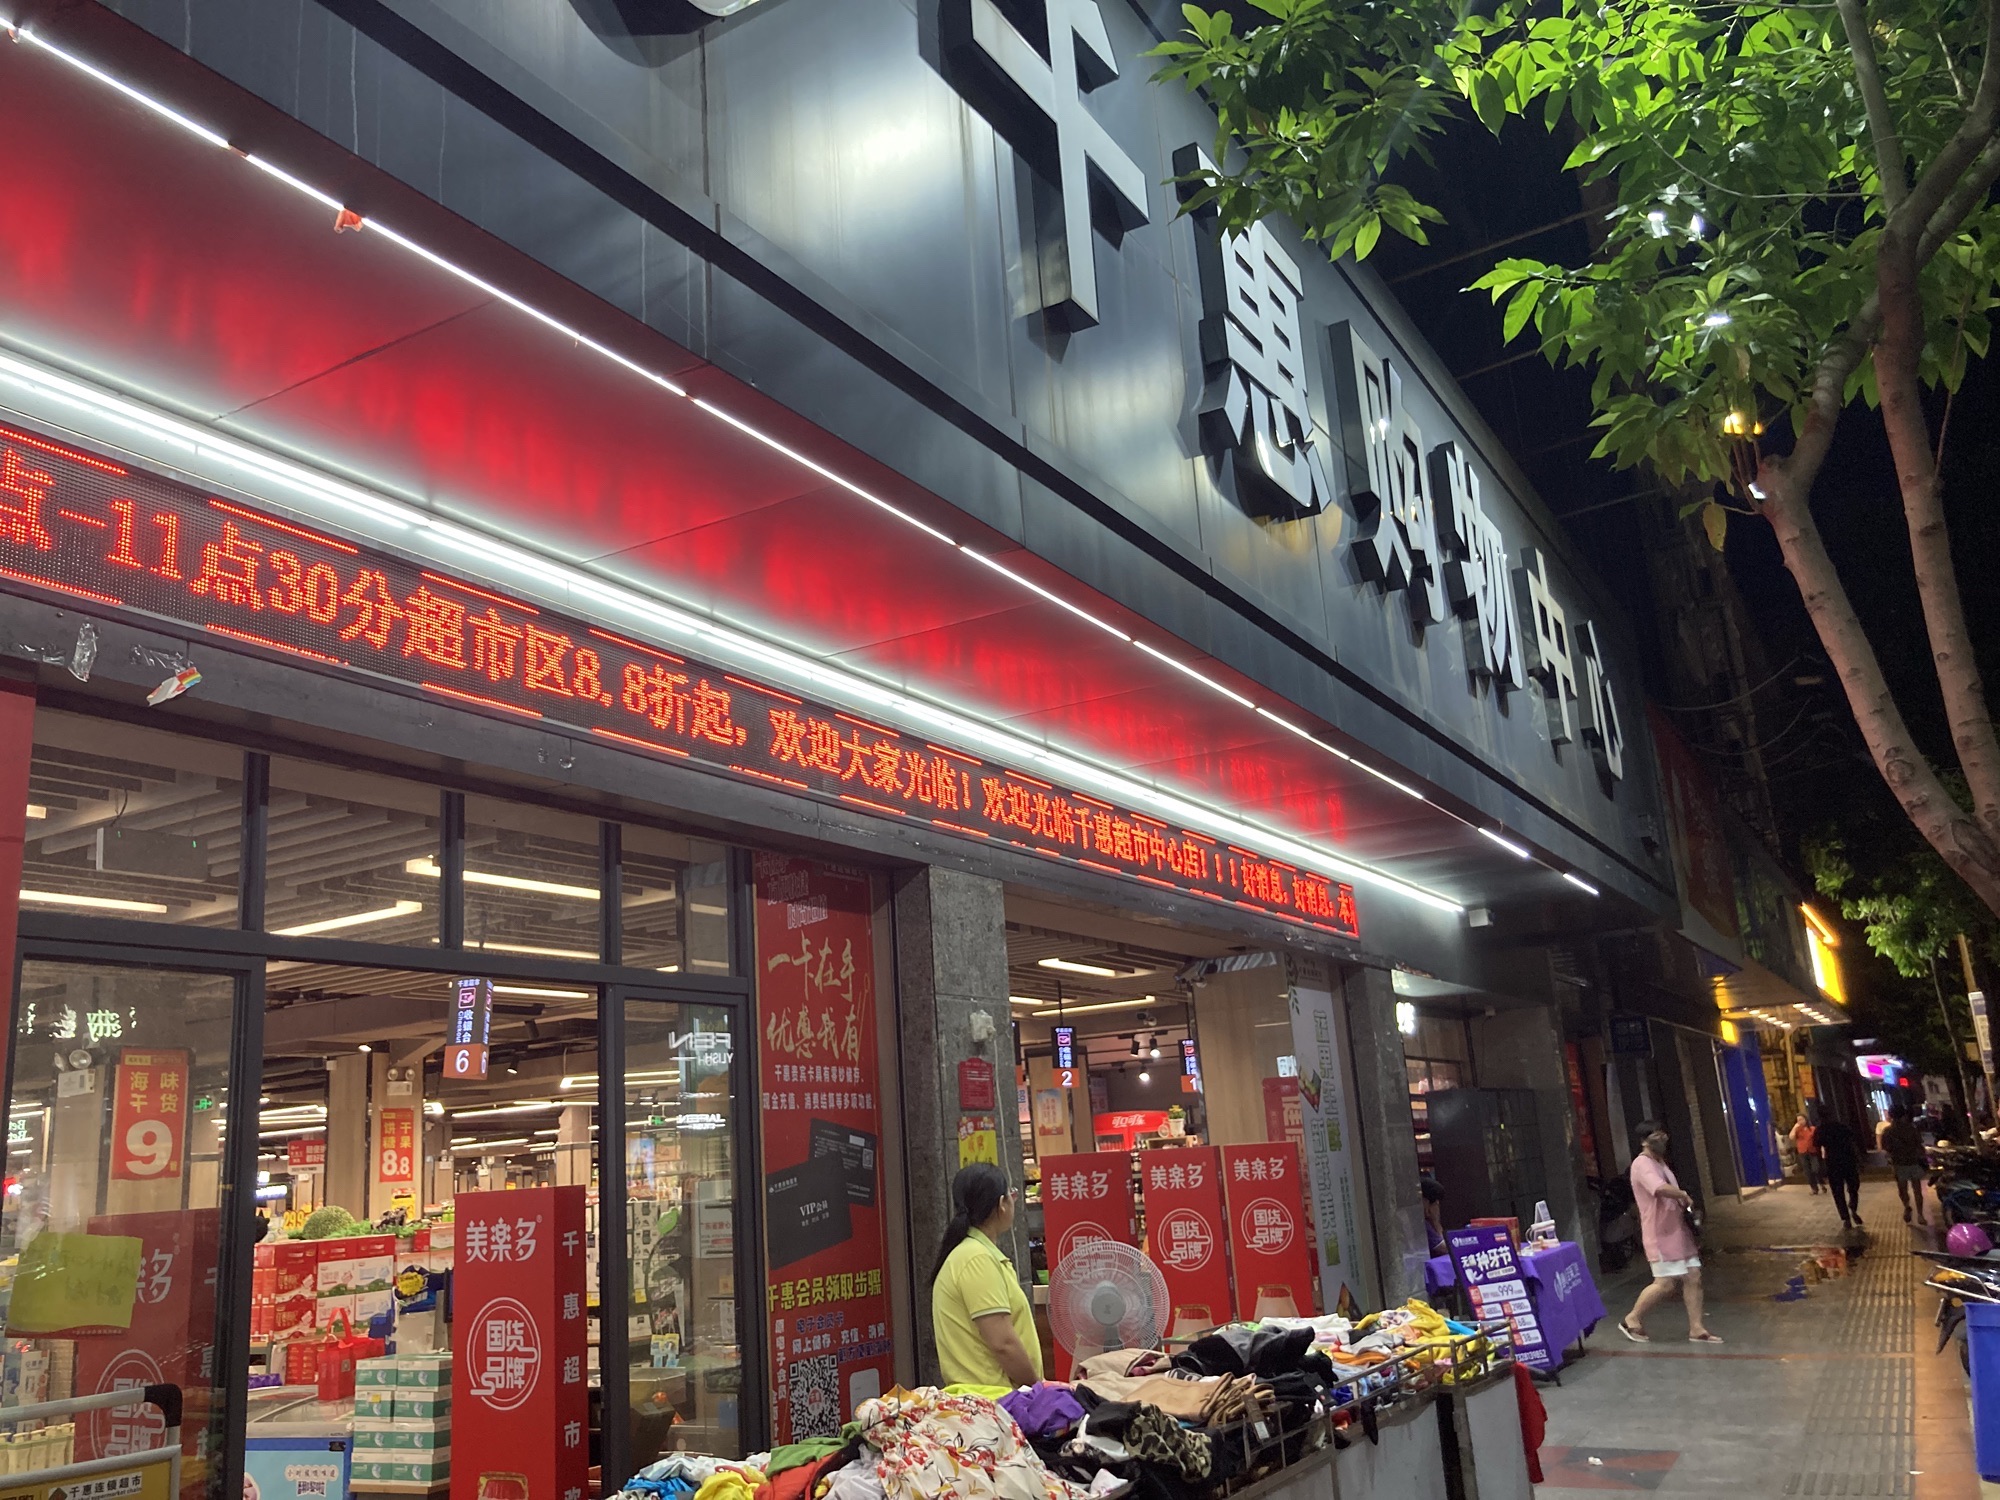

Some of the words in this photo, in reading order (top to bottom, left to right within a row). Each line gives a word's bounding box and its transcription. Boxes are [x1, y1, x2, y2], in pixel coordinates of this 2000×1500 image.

[455, 1049, 469, 1073] 6
[1061, 1070, 1073, 1086] 2
[126, 1119, 172, 1175] 9
[1498, 1284, 1514, 1297] 999
